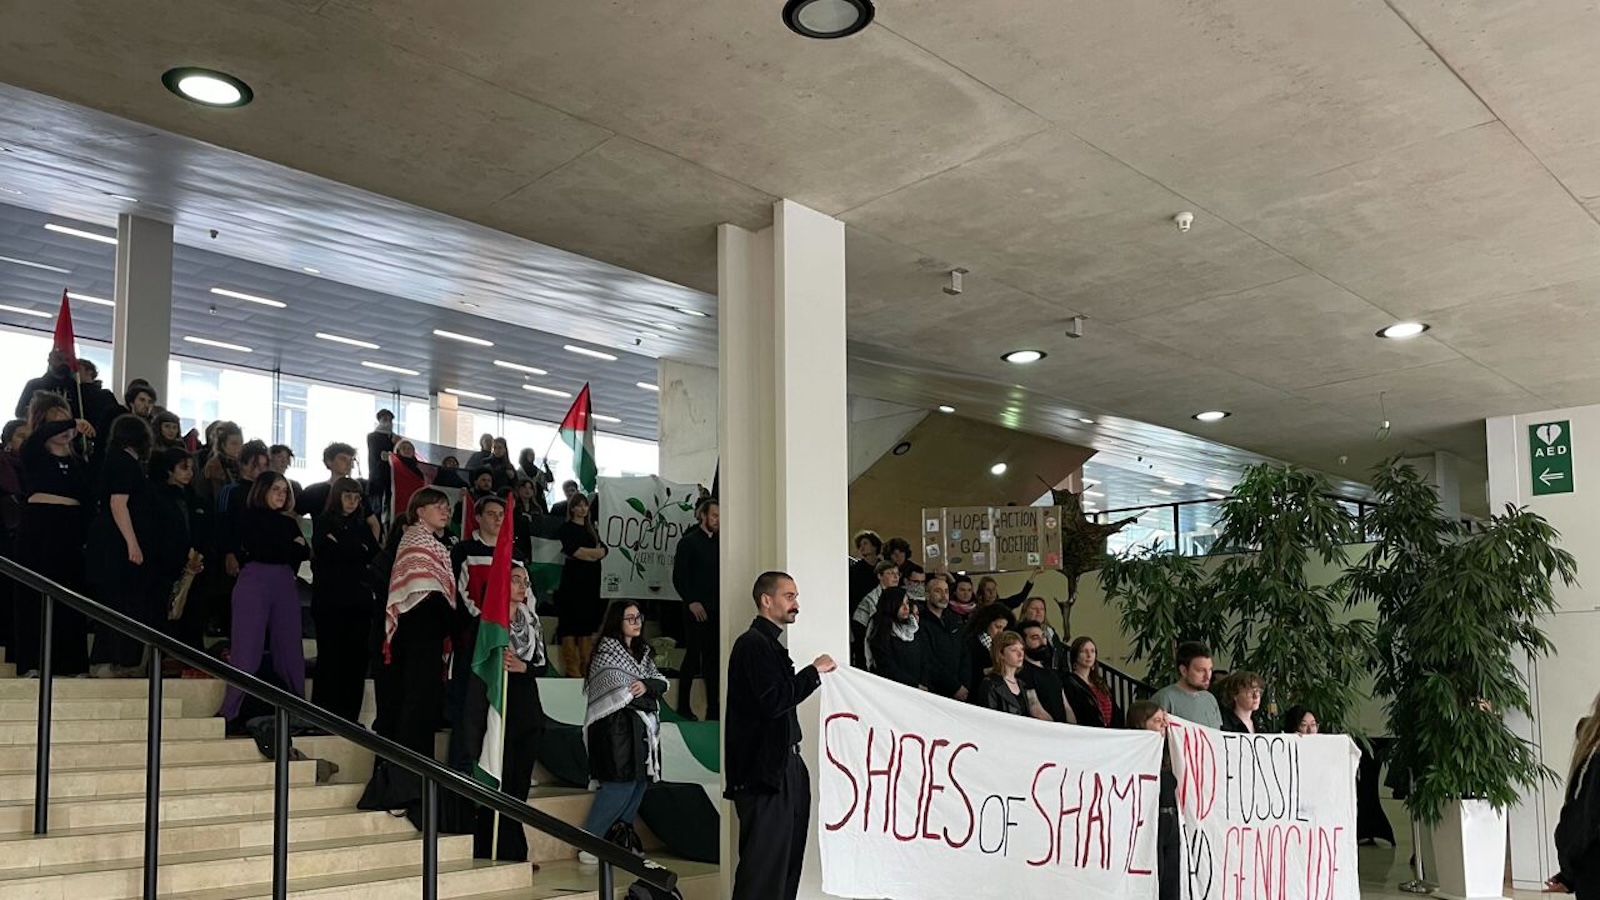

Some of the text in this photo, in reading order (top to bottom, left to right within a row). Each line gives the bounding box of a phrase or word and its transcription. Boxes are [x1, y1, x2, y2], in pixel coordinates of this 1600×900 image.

[1535, 445, 1567, 457] AED
[606, 515, 691, 552] OCCUPY
[952, 513, 988, 531] HOPE
[1000, 510, 1037, 528] ACTION
[960, 535, 1039, 554] GO TOGETHER
[825, 712, 1158, 875] SHOES OF SHAME
[1223, 735, 1309, 824] FOSSIL
[1222, 825, 1344, 900] GENOCIDE
